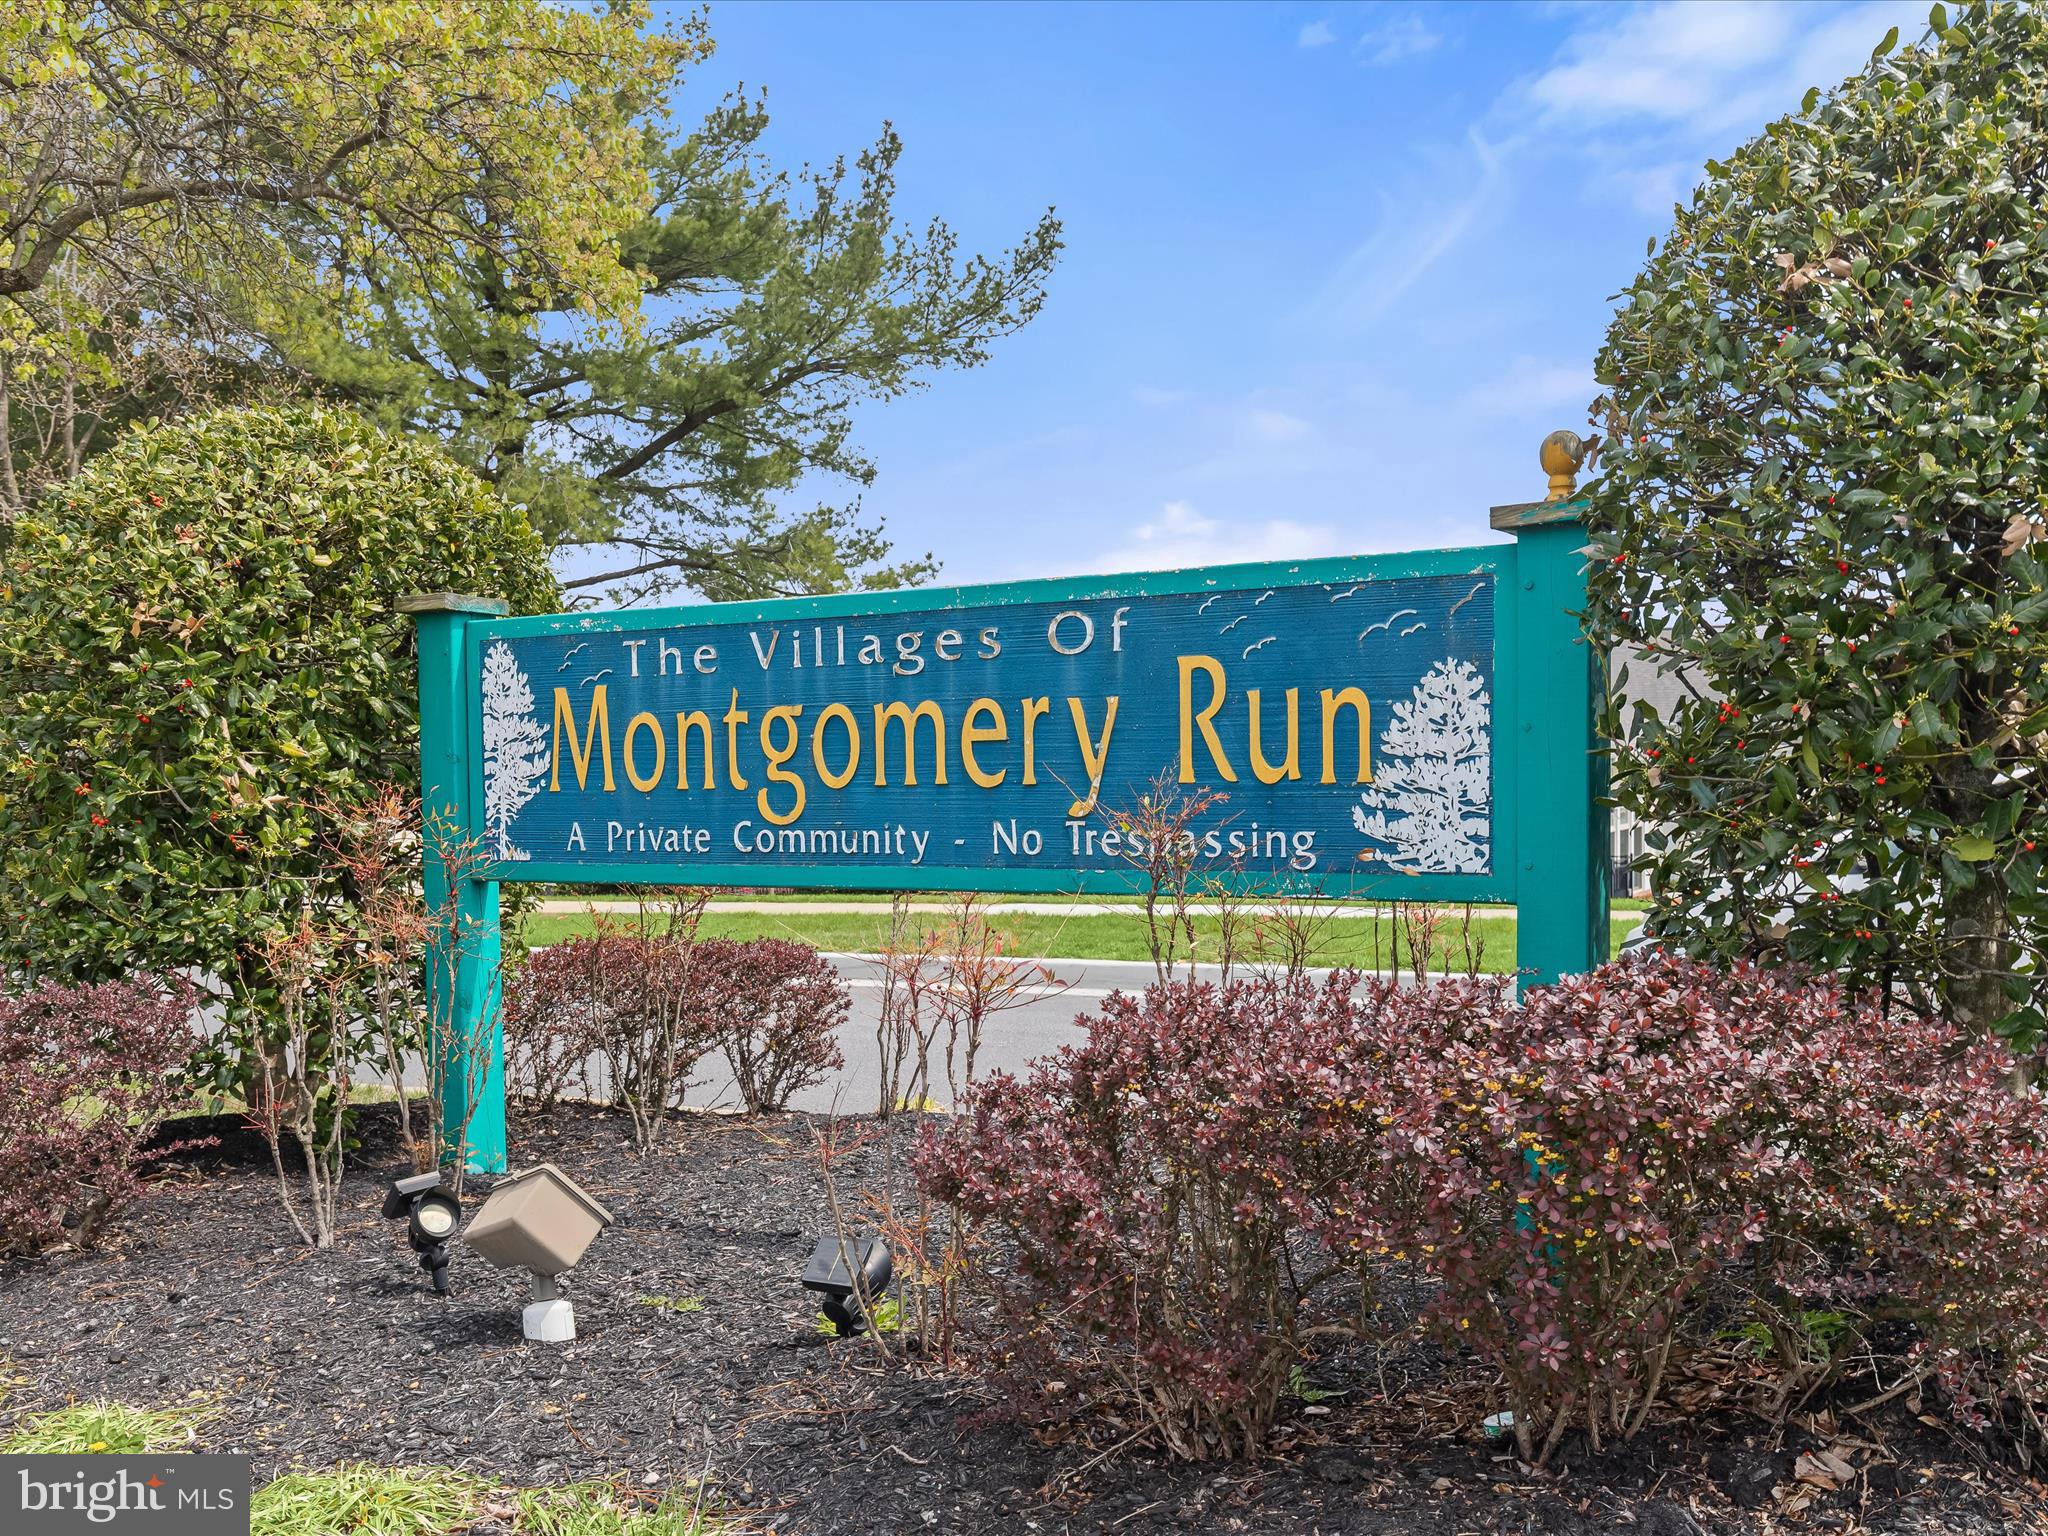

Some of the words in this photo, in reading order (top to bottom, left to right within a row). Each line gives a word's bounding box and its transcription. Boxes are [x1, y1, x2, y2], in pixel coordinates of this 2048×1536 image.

[623, 638, 718, 677] The
[749, 626, 1002, 676] Villages
[1047, 606, 1130, 654] Of
[549, 684, 1119, 826] Montgomery
[1176, 655, 1374, 784] Run
[567, 821, 586, 852] A
[607, 821, 711, 853] Private
[733, 820, 930, 865] Community
[993, 818, 1043, 856] No
